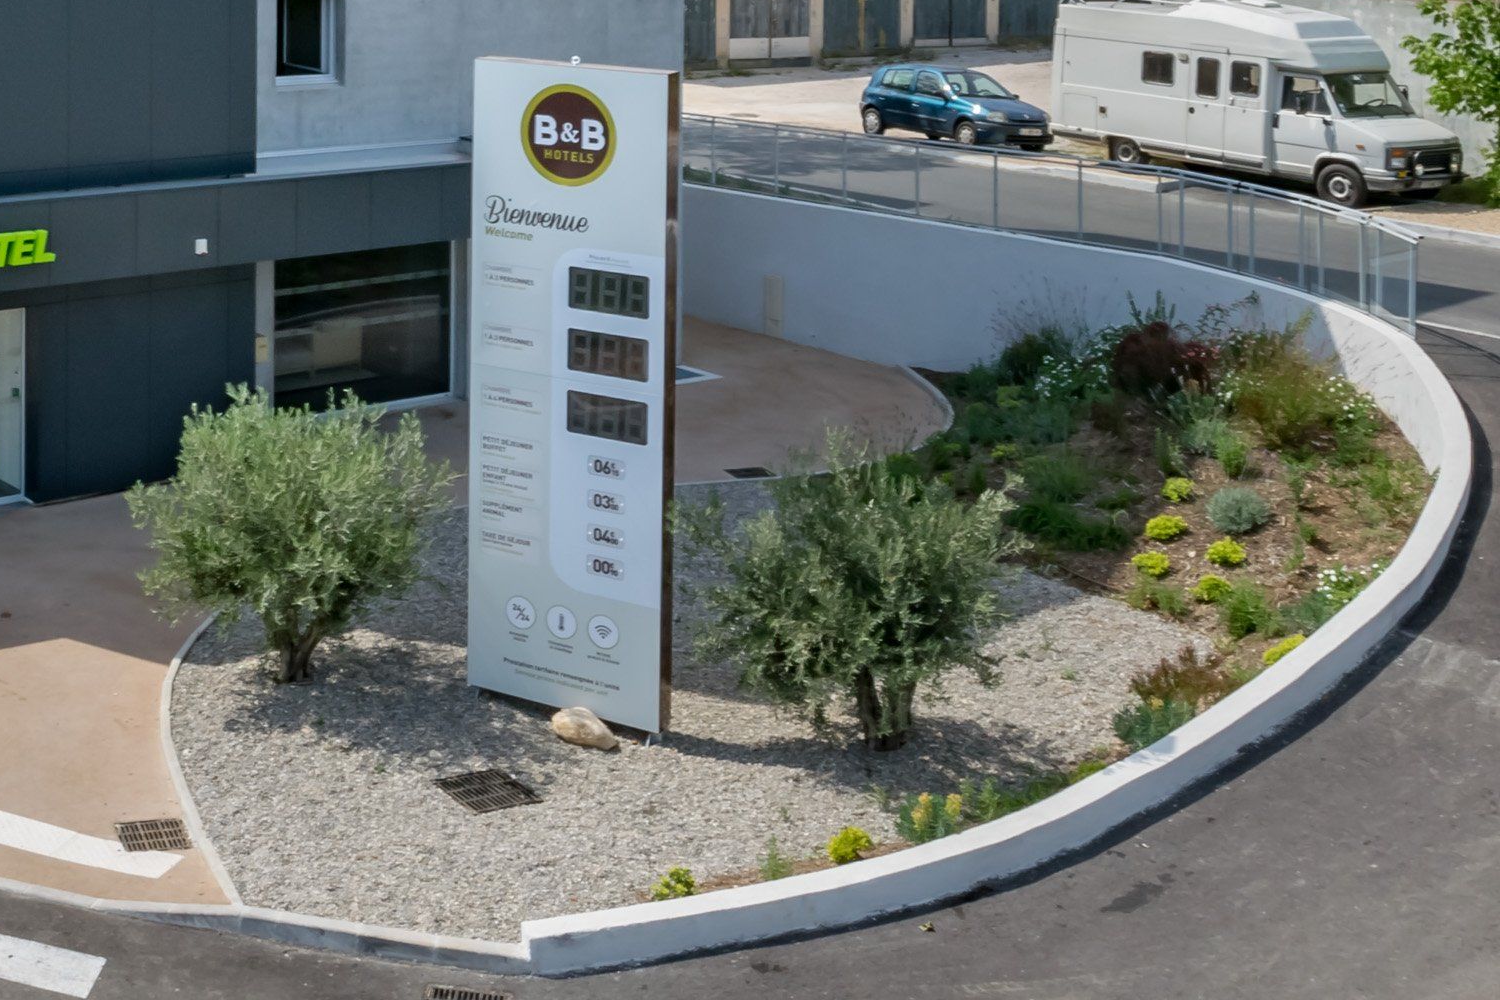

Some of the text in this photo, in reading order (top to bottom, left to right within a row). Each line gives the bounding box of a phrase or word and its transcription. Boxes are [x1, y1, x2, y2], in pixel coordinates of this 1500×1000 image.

[533, 113, 606, 151] B&B
[544, 149, 594, 164] HOTELS
[484, 195, 590, 233] Bienvenue
[484, 226, 534, 241] Welcome
